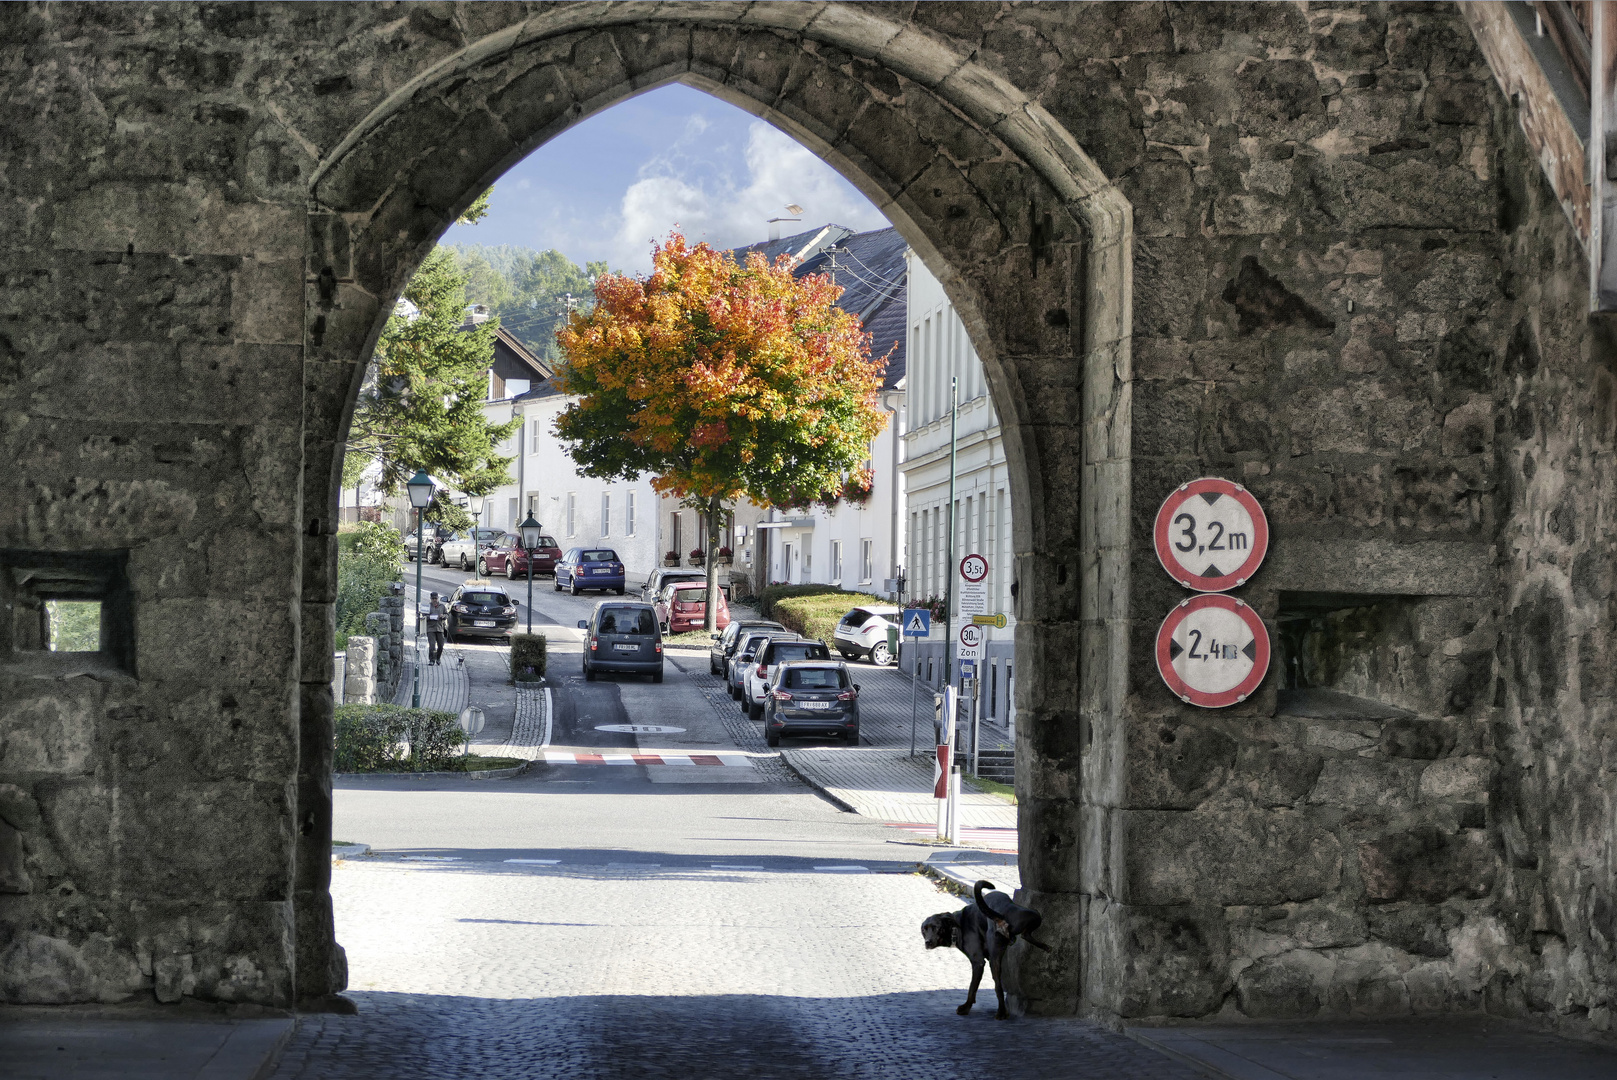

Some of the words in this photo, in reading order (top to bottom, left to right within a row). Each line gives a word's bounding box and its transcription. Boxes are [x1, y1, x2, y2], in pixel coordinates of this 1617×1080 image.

[1173, 512, 1248, 557] 3,2m
[966, 561, 982, 574] 3,5t
[961, 648, 978, 657] Zon
